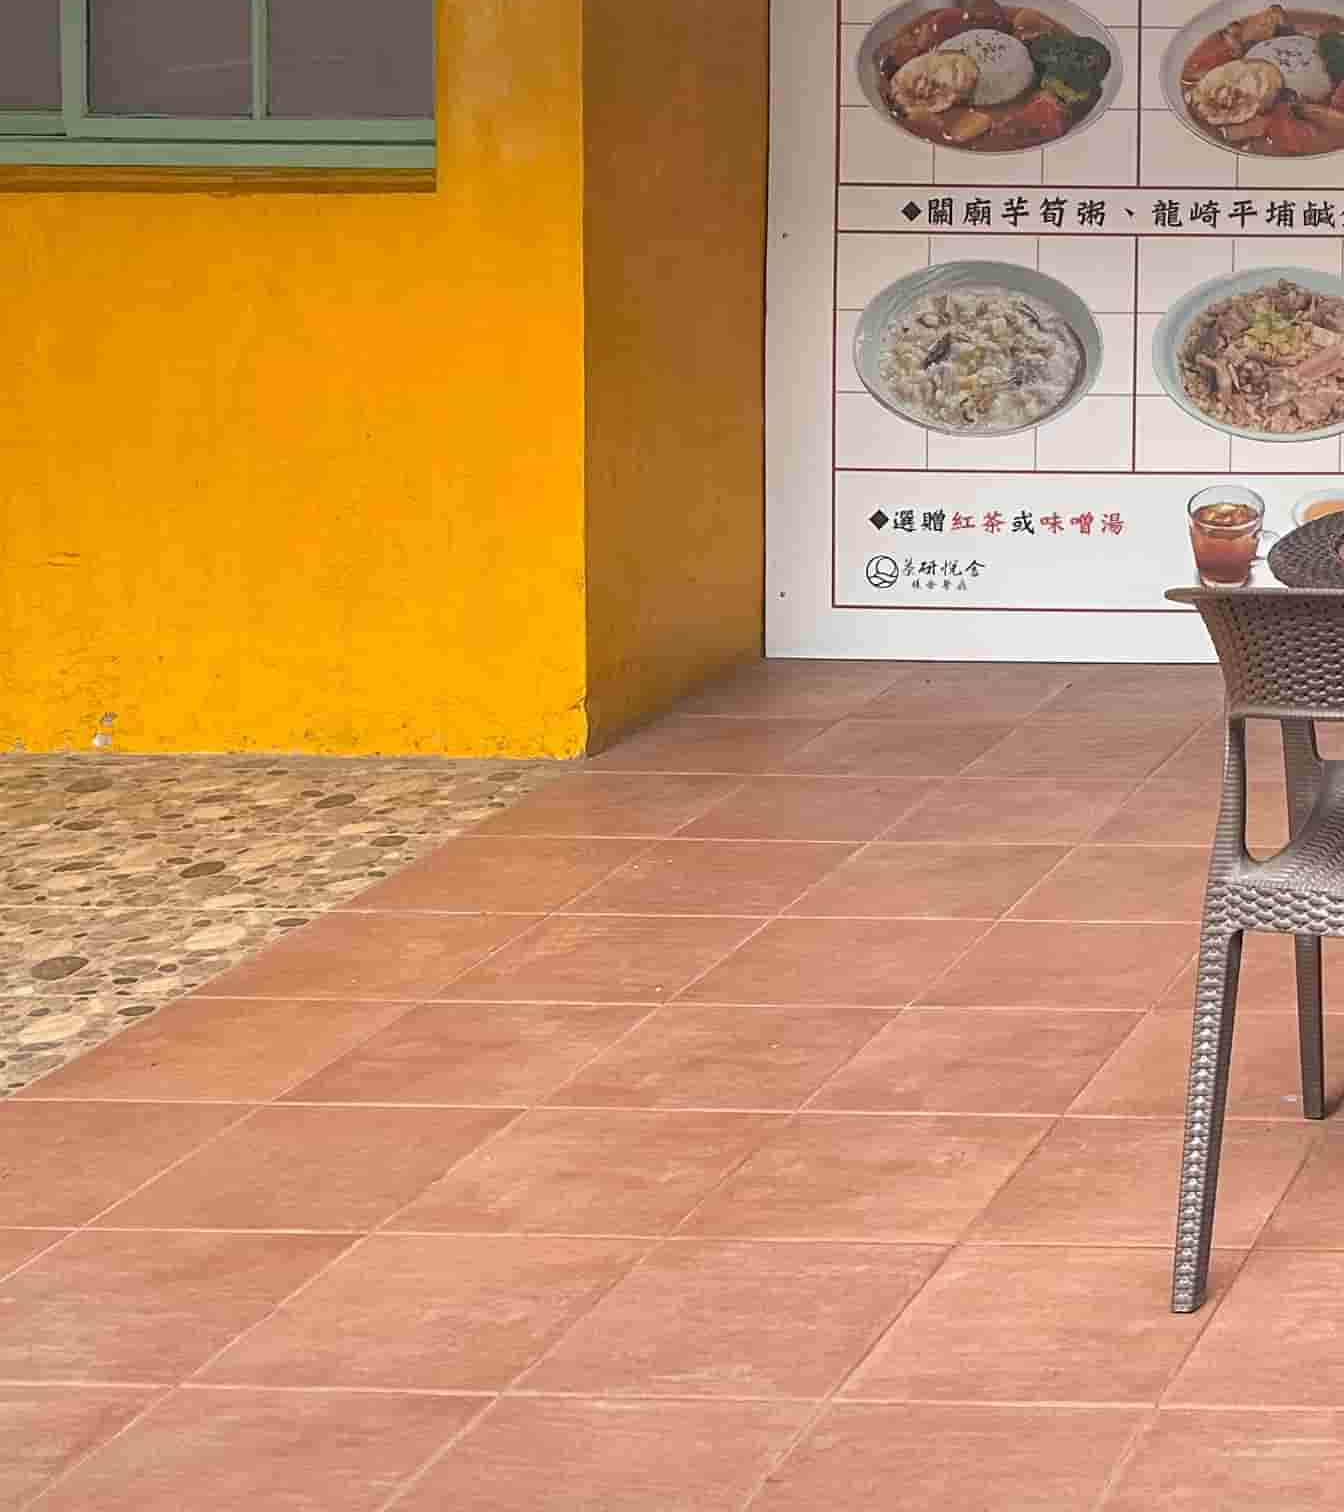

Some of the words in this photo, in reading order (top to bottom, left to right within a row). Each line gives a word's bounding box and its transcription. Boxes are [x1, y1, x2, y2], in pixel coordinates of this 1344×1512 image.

[892, 509, 1126, 536] 選贈紅茶或味噌湯
